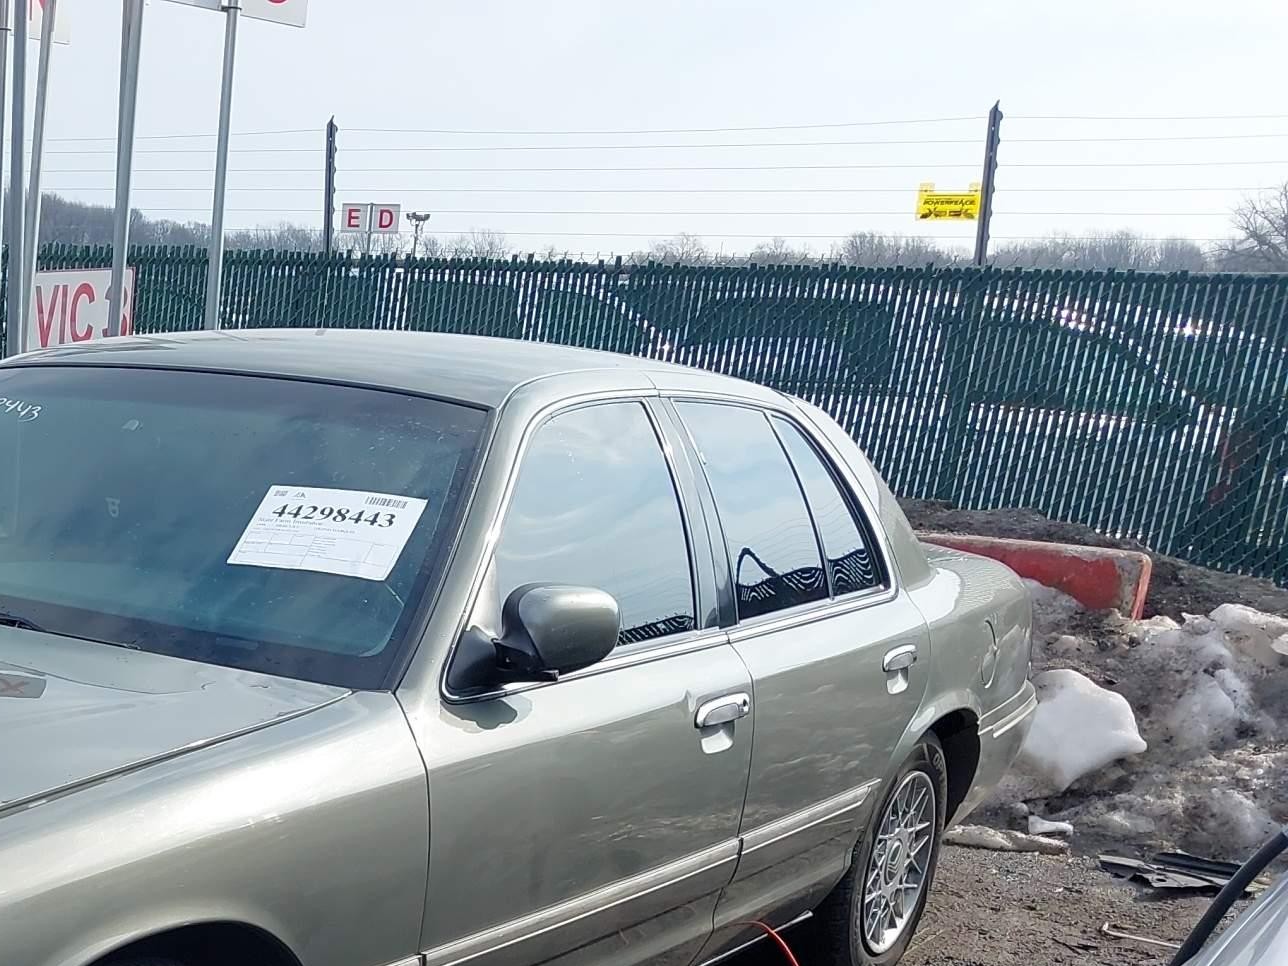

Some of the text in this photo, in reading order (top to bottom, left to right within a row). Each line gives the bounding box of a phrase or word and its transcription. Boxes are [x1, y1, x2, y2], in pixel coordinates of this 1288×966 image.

[347, 208, 394, 229] E D
[35, 282, 96, 348] VIC
[272, 503, 396, 528] 44298443
